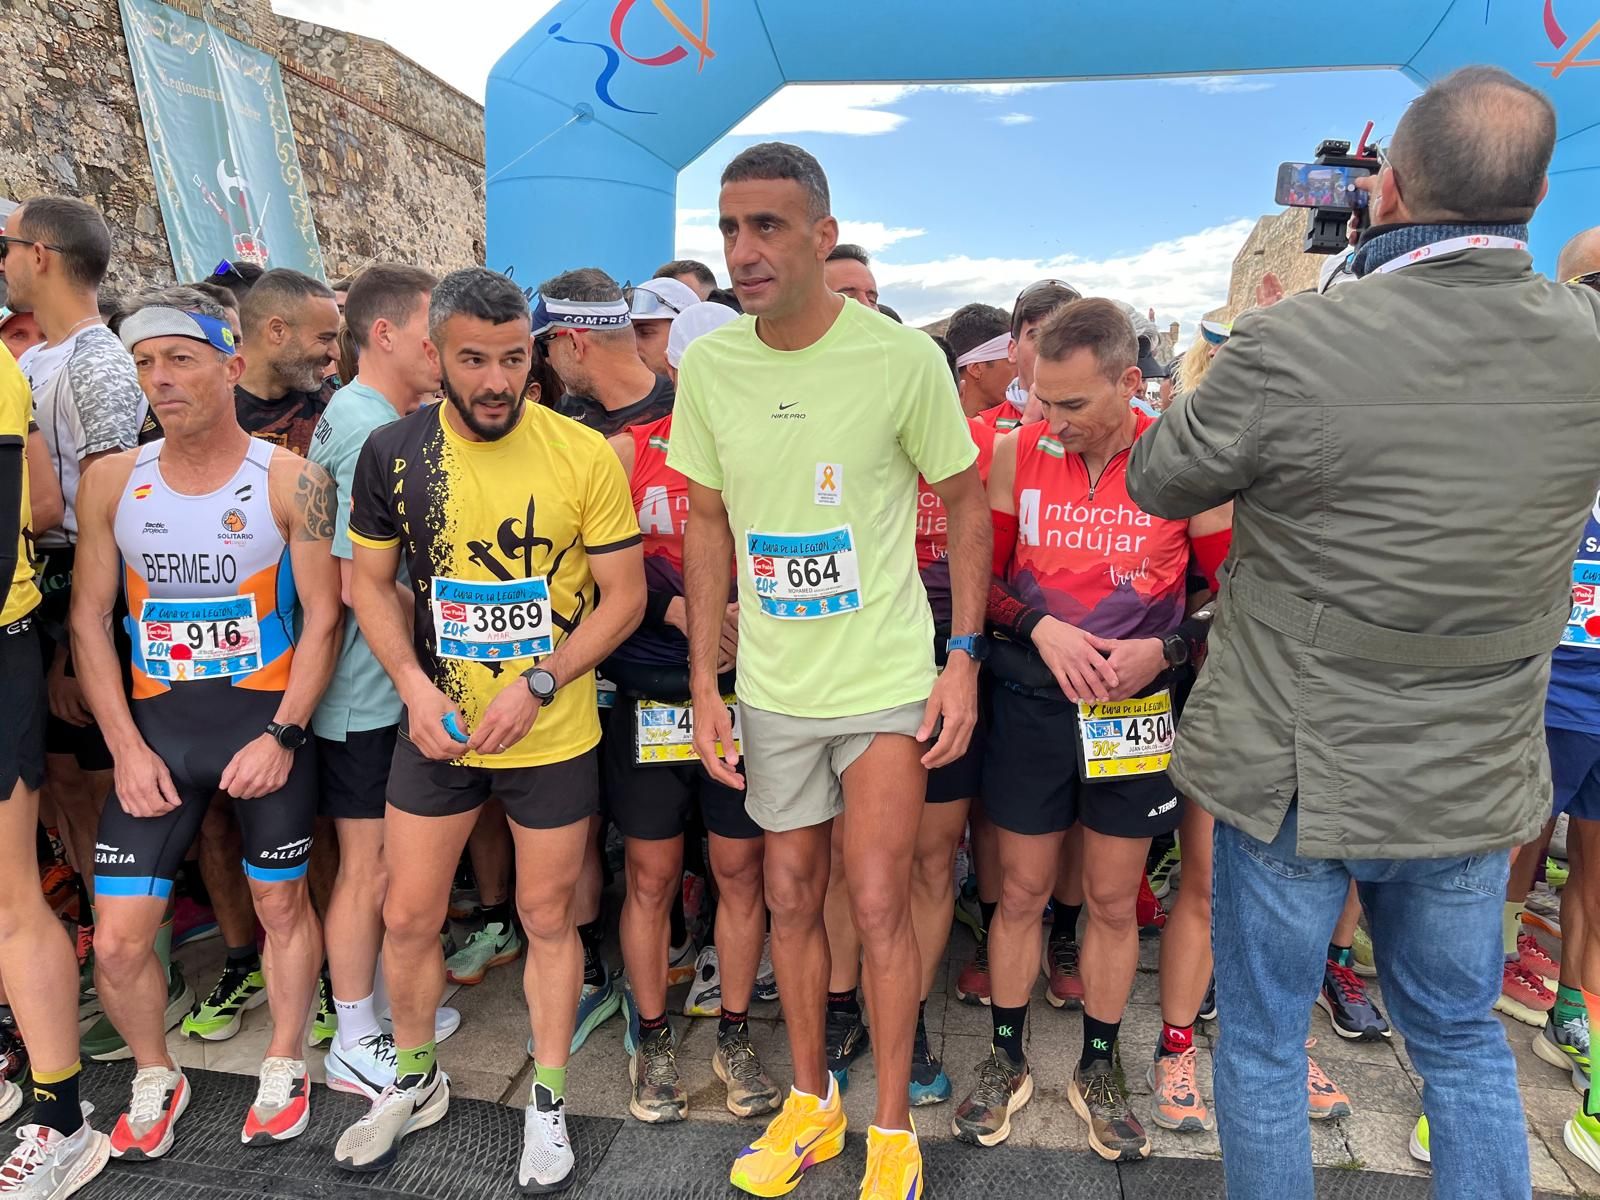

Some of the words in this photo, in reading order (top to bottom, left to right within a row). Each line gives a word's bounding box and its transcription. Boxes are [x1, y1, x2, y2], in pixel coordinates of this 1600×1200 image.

[751, 539, 758, 551] X
[142, 553, 237, 584] BERMEJO
[787, 555, 840, 588] 664
[1104, 557, 1150, 586] trail
[440, 585, 448, 597] X
[756, 577, 778, 594] 20K
[145, 606, 155, 618] X
[472, 602, 543, 632] 3869
[187, 620, 241, 649] 916
[442, 621, 470, 637] 20K
[1088, 704, 1098, 717] X
[1126, 714, 1173, 745] 4304
[1092, 740, 1120, 756] 50K
